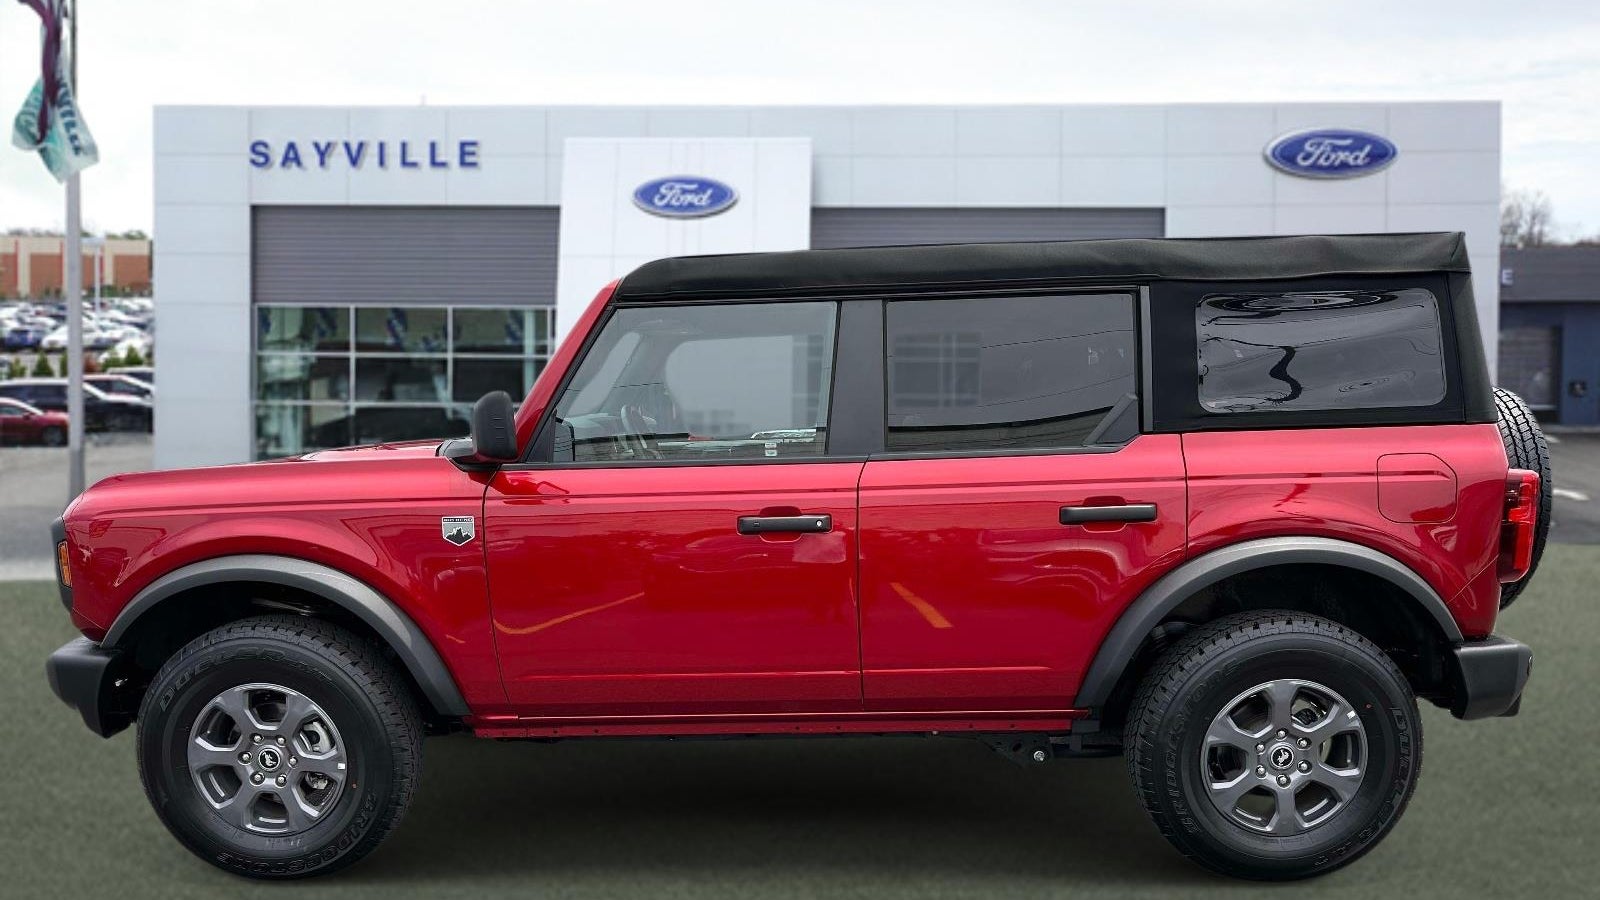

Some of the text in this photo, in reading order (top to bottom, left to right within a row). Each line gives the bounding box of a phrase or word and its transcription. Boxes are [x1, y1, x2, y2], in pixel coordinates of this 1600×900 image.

[249, 140, 479, 168] SAYVILLE
[1297, 138, 1372, 166] Ford
[654, 182, 713, 206] Ford
